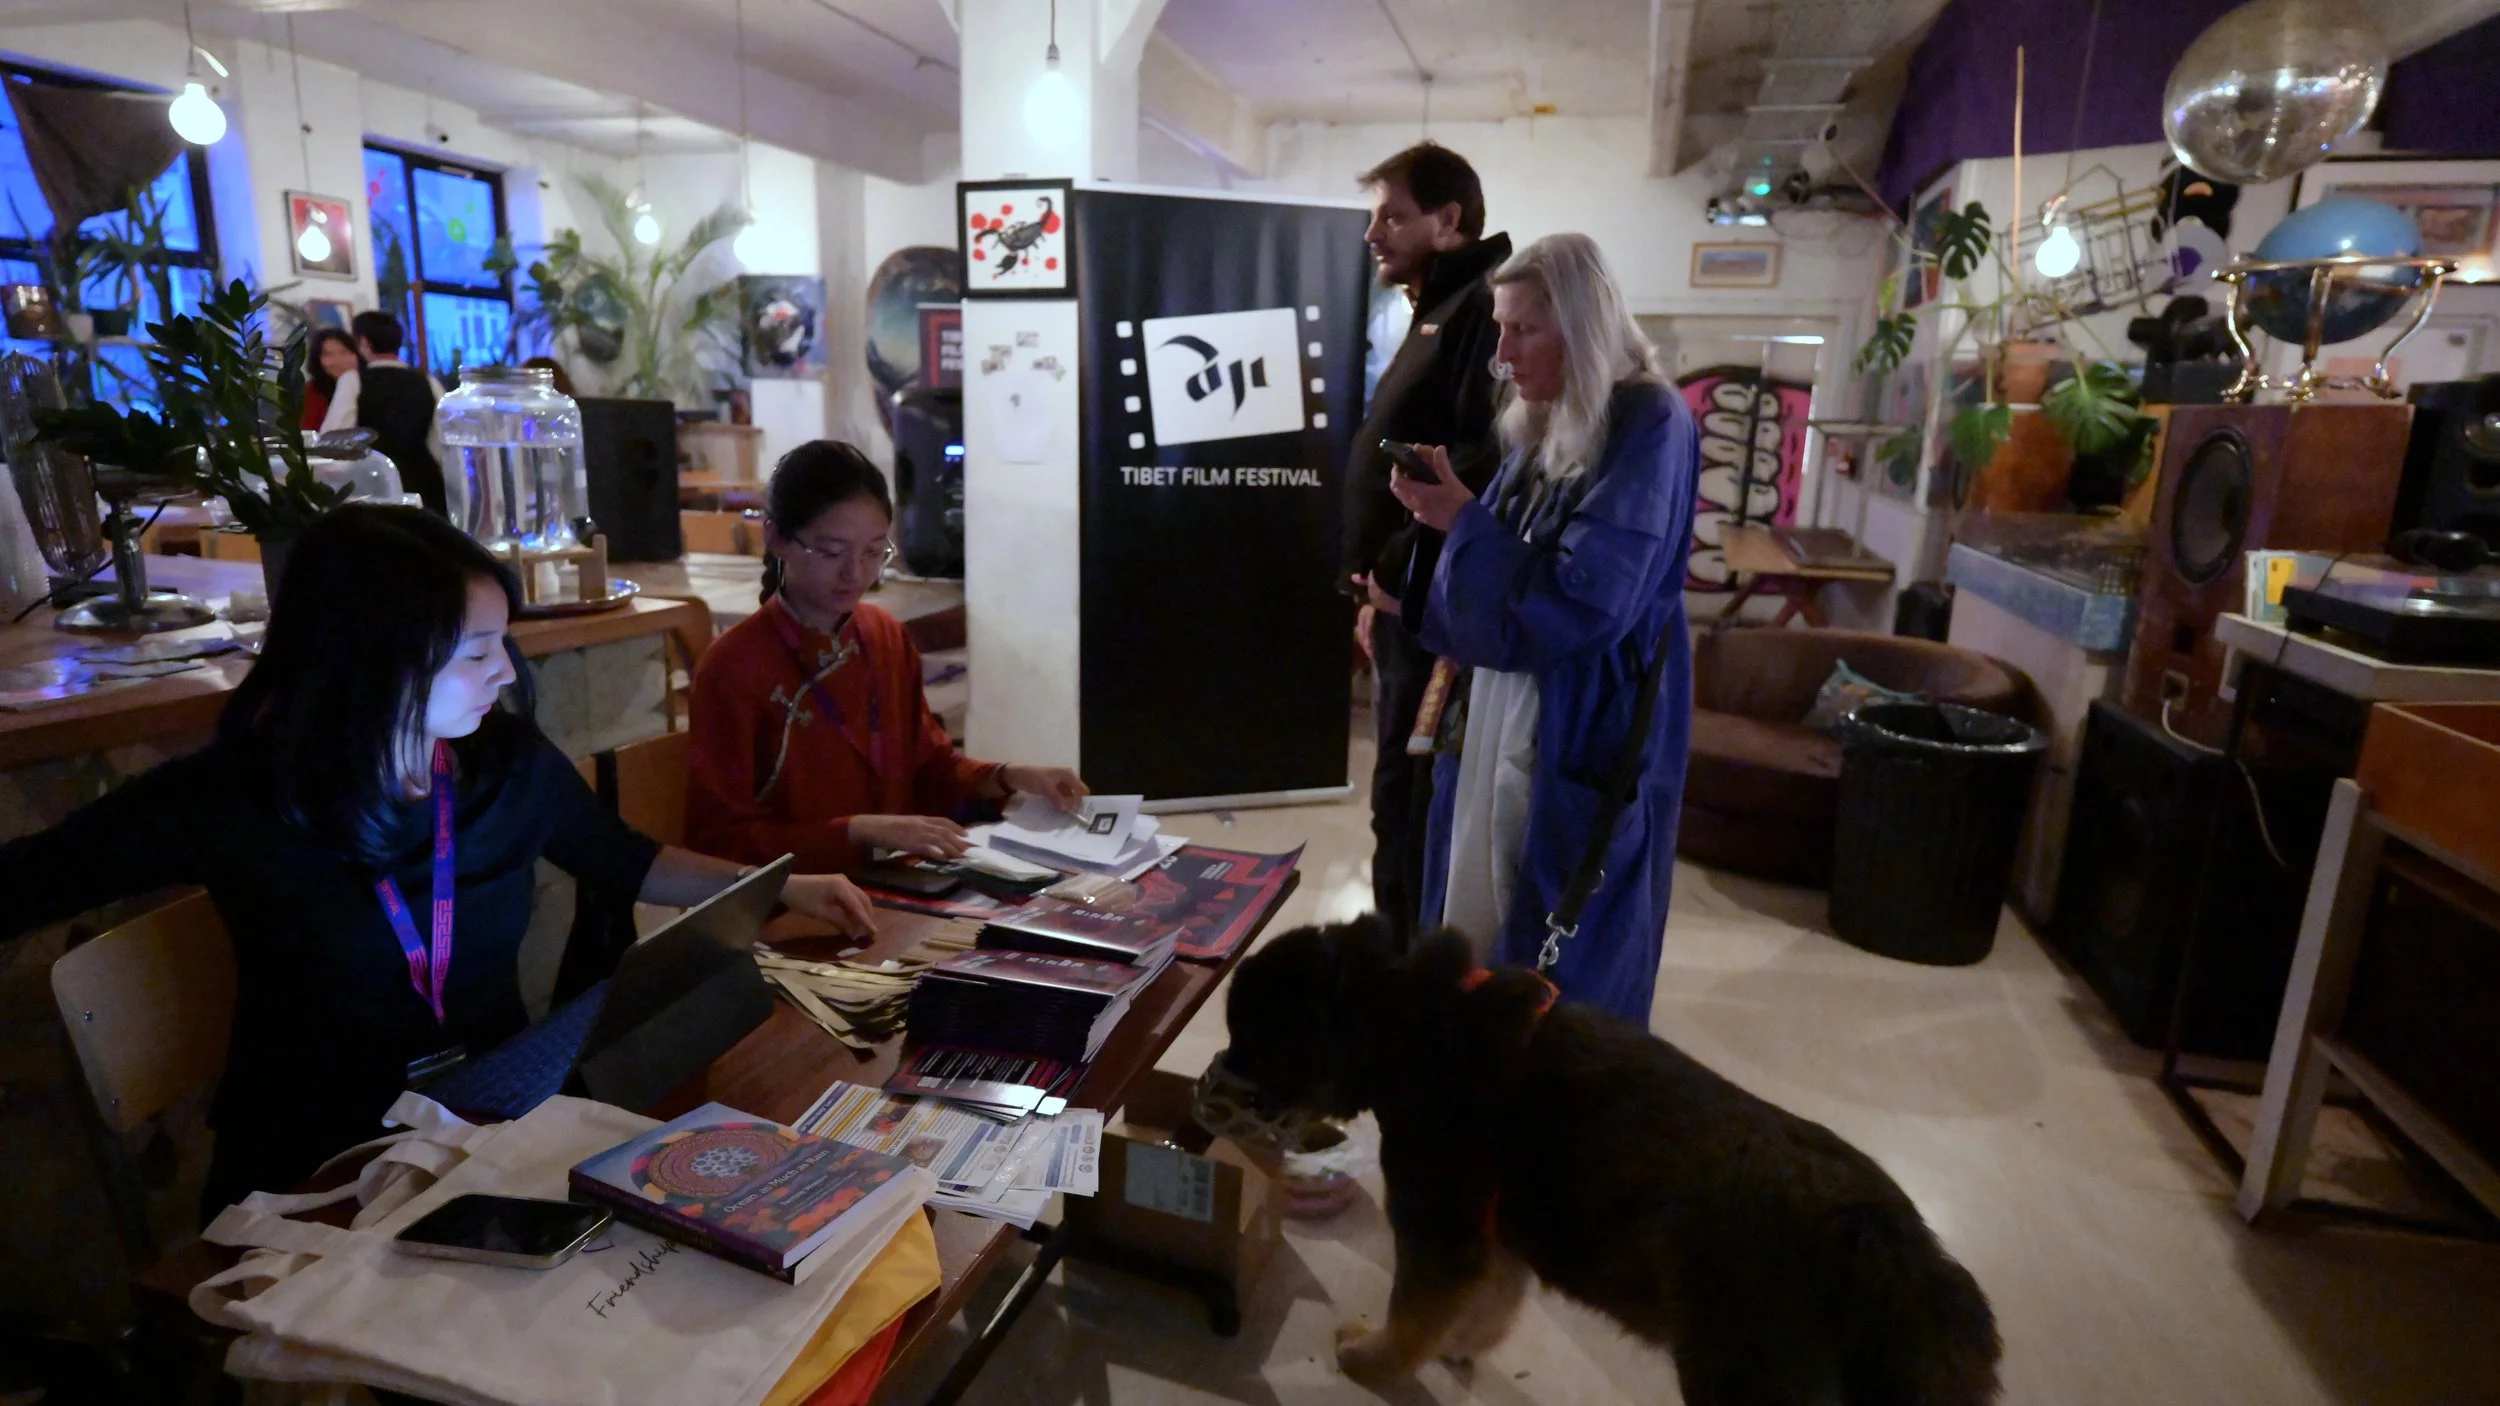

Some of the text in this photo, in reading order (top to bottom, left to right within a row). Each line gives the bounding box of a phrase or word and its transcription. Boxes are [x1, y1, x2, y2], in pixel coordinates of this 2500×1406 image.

[1120, 466, 1321, 487] TIBET FILM FESTIVAL
[770, 1170, 799, 1187] Much
[807, 1149, 830, 1165] Rain
